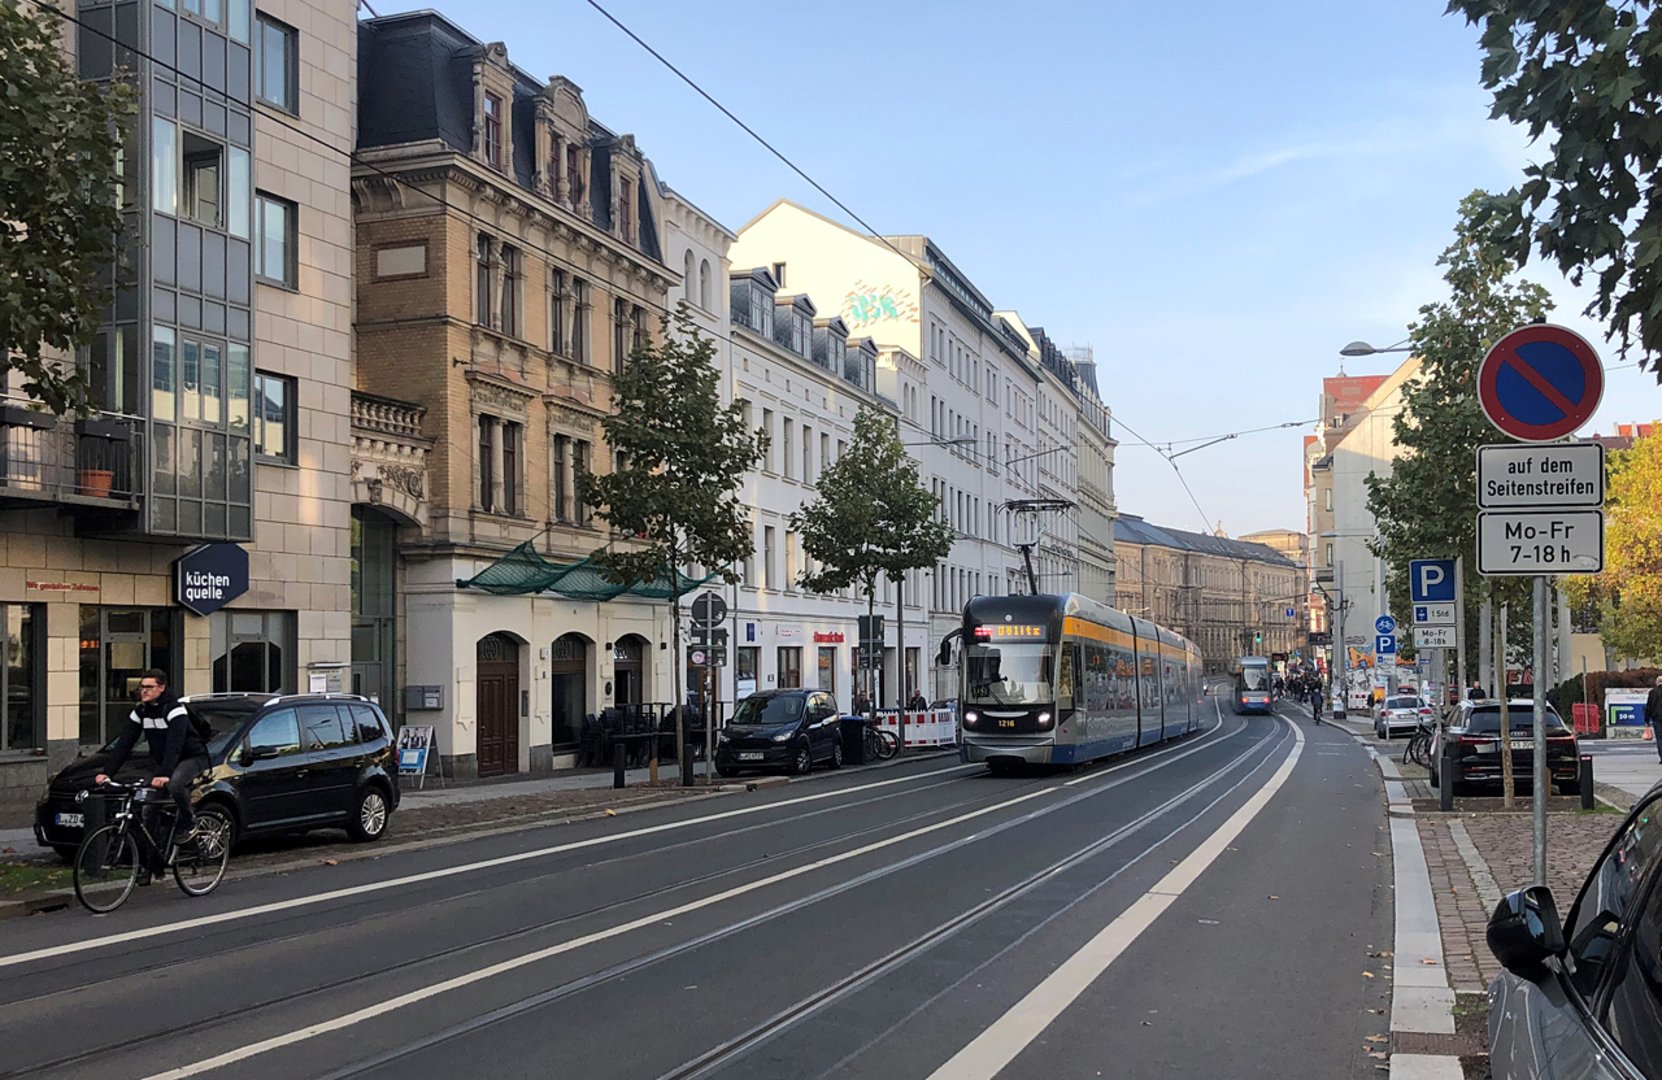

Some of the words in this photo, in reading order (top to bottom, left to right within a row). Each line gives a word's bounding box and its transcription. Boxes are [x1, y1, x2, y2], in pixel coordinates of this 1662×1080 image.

[1508, 457, 1533, 474] auf
[1540, 457, 1573, 473] dem
[1487, 478, 1594, 496] Seitenstreifen
[1505, 521, 1574, 539] Mo-Fr
[1510, 545, 1555, 563] 7-18
[1561, 545, 1570, 562] h
[186, 571, 230, 587] küchen
[186, 586, 223, 602] quelle
[1422, 629, 1447, 637] Mo-Fr
[998, 720, 1015, 728] 1216
